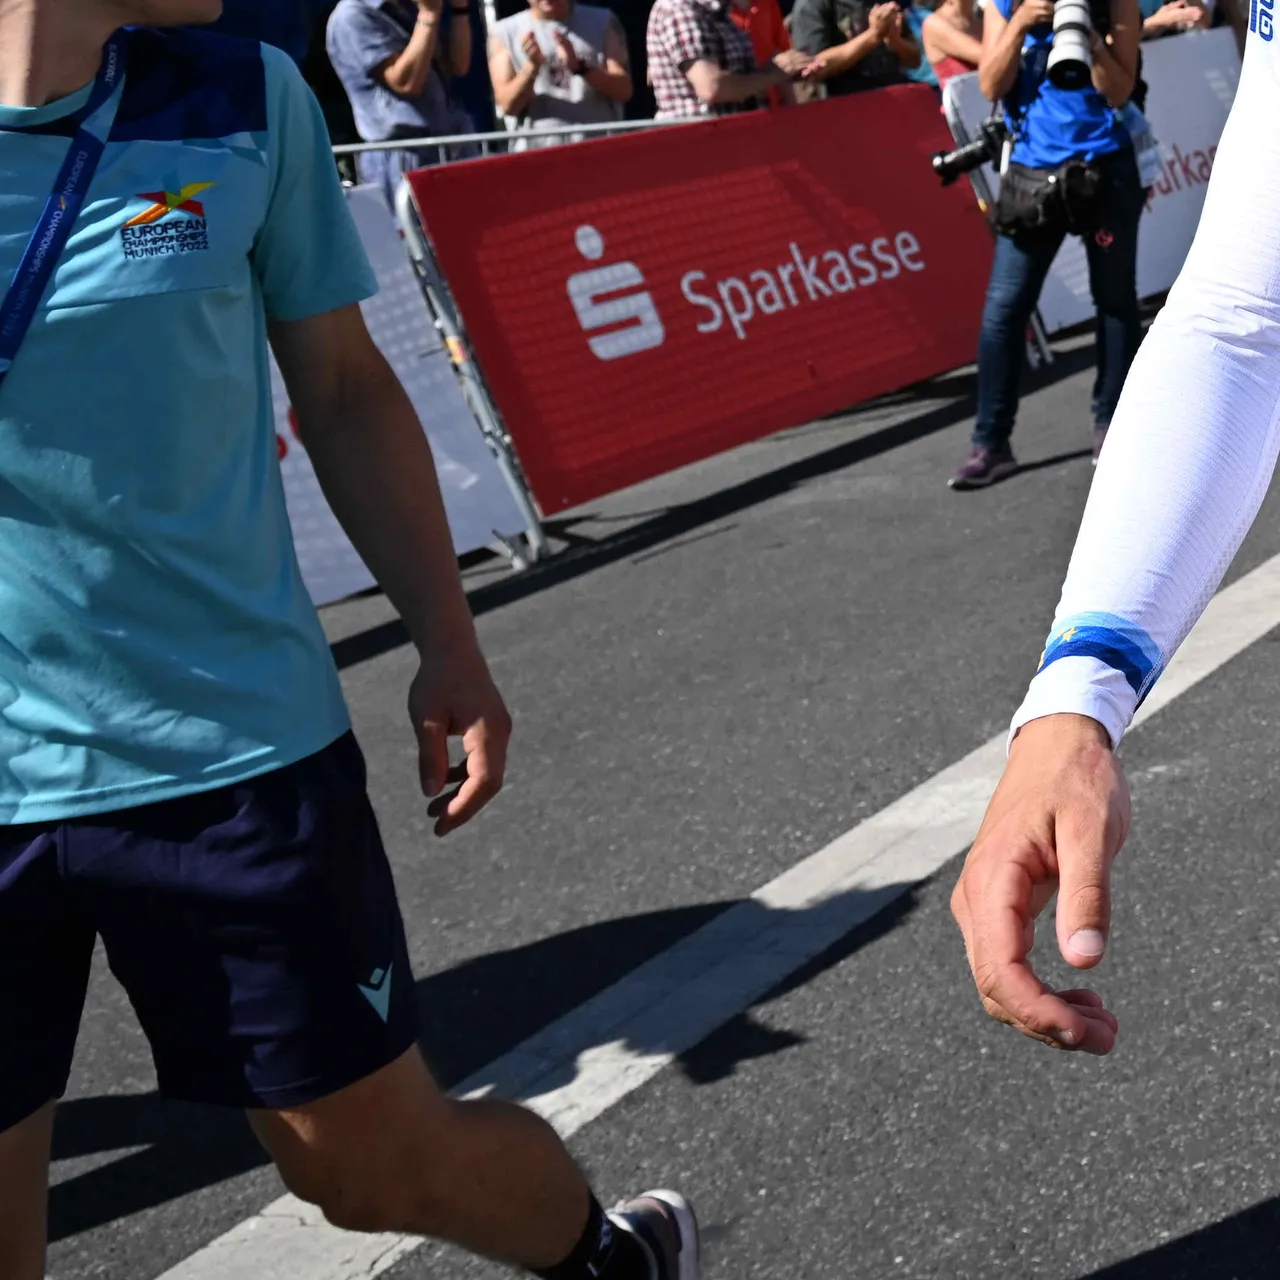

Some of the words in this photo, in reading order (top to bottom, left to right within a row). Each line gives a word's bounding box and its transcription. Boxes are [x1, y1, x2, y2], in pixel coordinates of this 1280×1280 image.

[62, 150, 88, 196] EUROPEAN
[31, 210, 64, 273] CHAMPIONSHIPS
[121, 219, 208, 241] EUROPEAN
[122, 231, 208, 251] CHAMPIONSHIPS
[124, 243, 176, 259] MUNICH
[180, 240, 209, 253] 2022
[680, 229, 926, 341] Sparkasse
